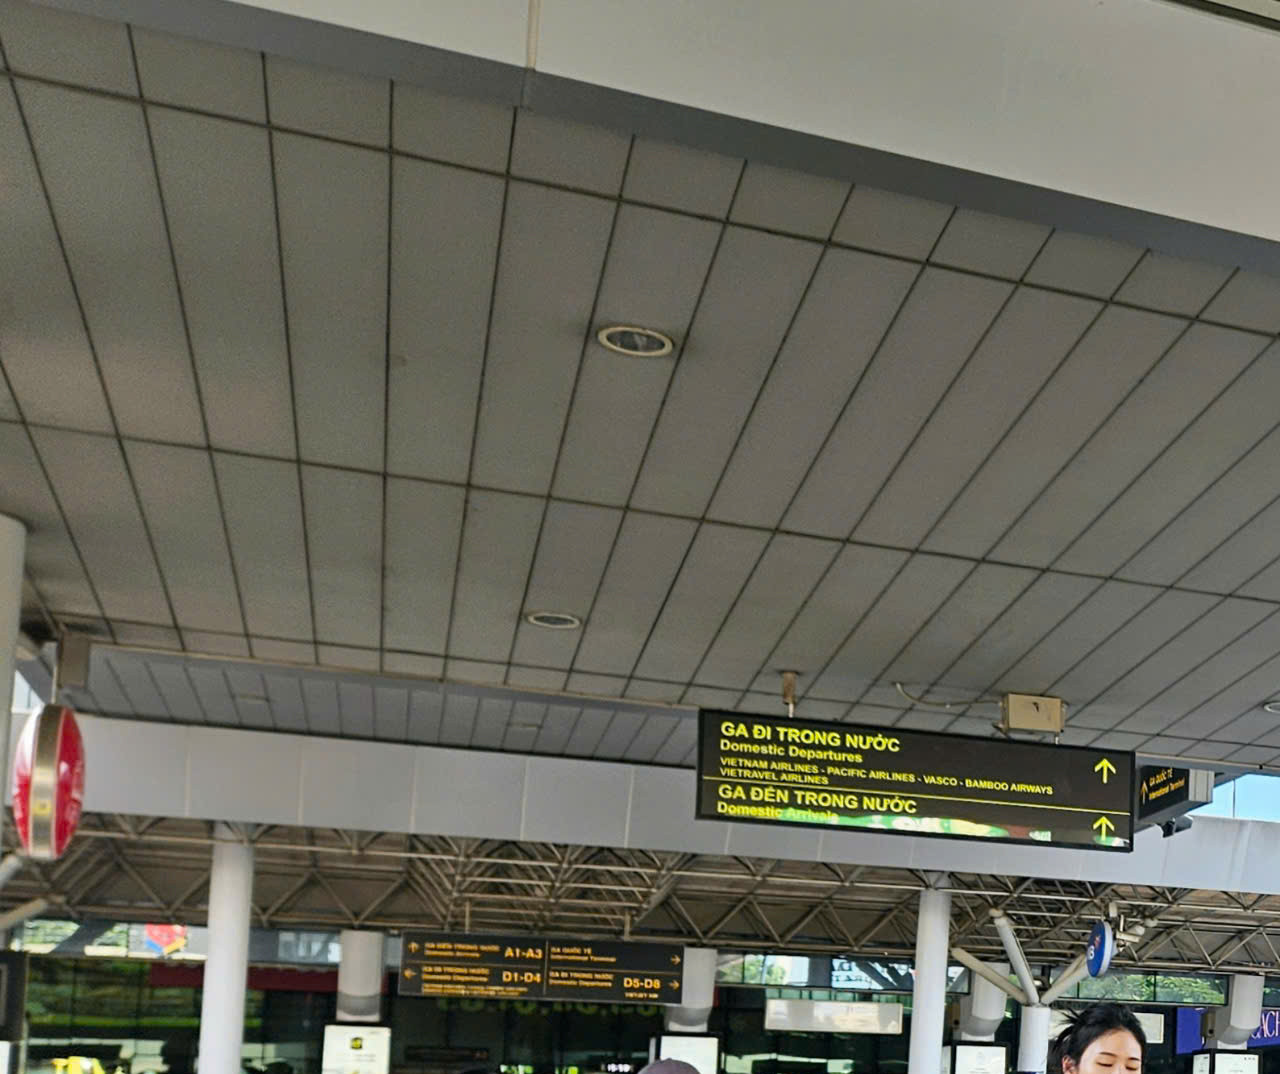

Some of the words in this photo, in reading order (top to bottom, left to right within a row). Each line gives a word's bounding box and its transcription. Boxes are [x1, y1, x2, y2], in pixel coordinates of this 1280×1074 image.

[721, 721, 748, 738] GA
[752, 724, 771, 740] ĐI
[776, 727, 841, 746] TRONG
[845, 733, 900, 752] NƯỚC
[720, 739, 785, 756] Domestic
[789, 745, 862, 763] Departures
[720, 757, 768, 769] VIETNAM
[771, 762, 819, 774] AIRLINES
[827, 766, 866, 778] PACIFIC
[869, 771, 915, 783] AIRLINES
[923, 775, 957, 786] VASCO
[965, 779, 1009, 791] BAMBOO
[1010, 783, 1053, 795] AIRWAYS
[720, 767, 778, 781] VIETRAVEL
[780, 773, 829, 785] AIRLINES
[718, 784, 746, 800] GA
[794, 790, 858, 809] TRONG
[717, 801, 783, 817] Domestic
[504, 947, 543, 960] A1-A3
[502, 971, 542, 983] D1-D4
